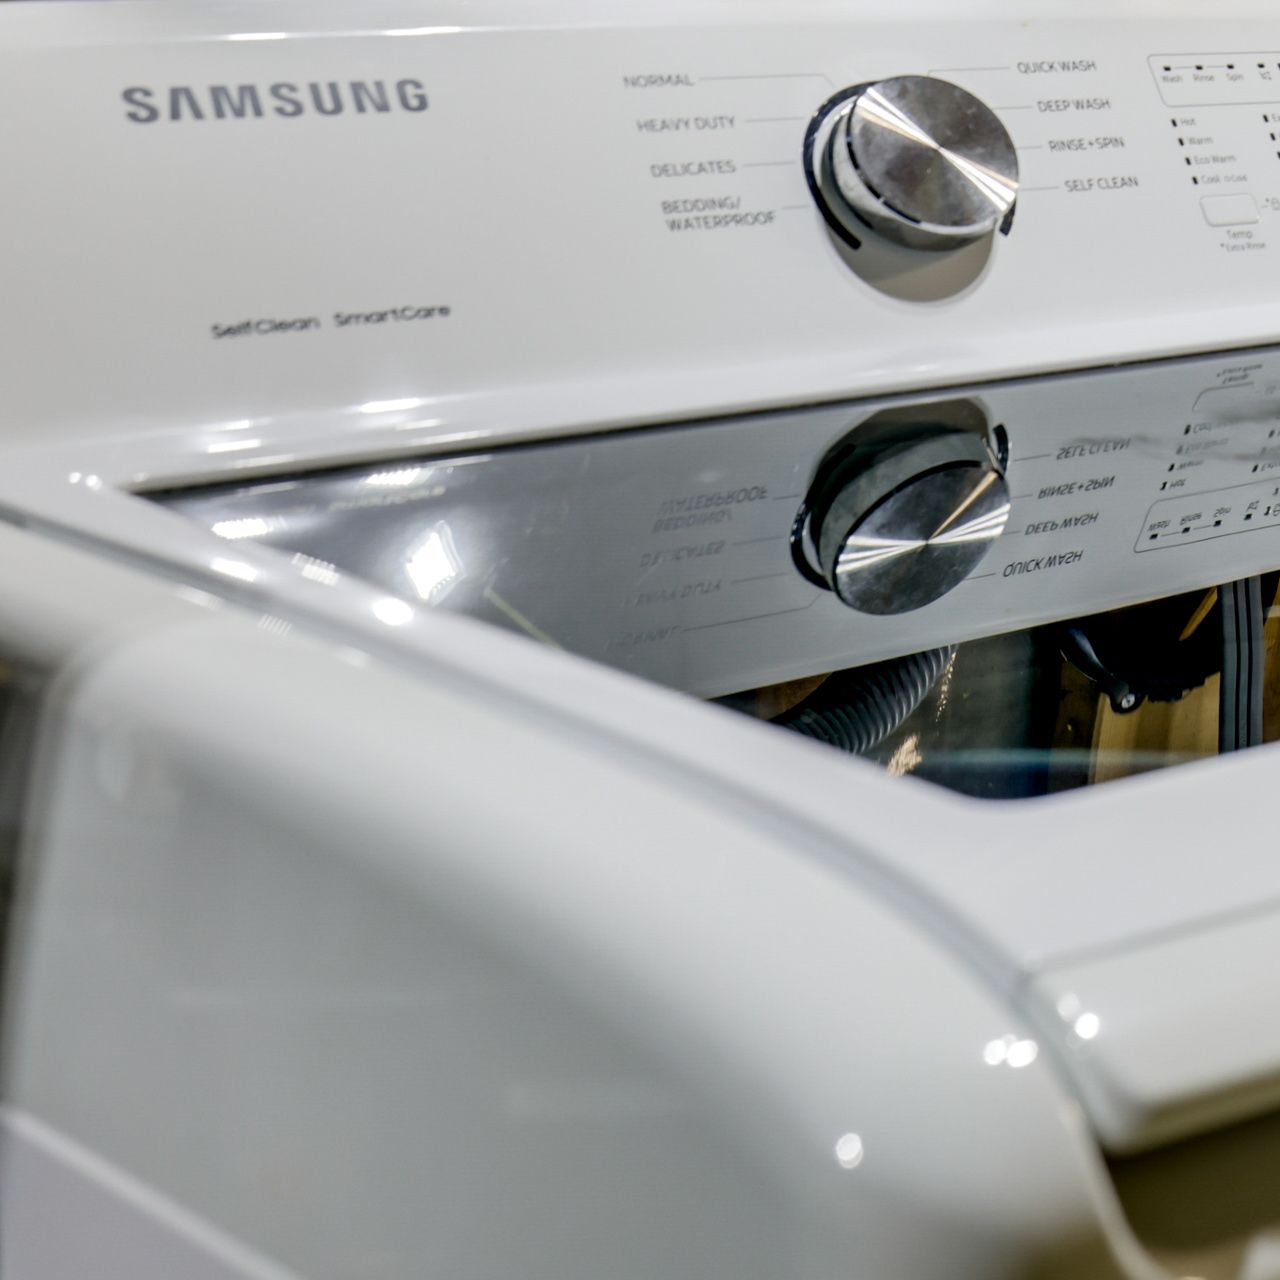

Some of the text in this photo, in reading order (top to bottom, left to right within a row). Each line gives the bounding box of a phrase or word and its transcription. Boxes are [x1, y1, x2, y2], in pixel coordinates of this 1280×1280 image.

[1016, 59, 1097, 75] QUICK WASH
[622, 73, 695, 89] NORMAL
[121, 77, 430, 125] SAMSUNG
[1036, 97, 1112, 113] DEEP WASH
[635, 115, 736, 133] HEAVY DUTY
[1048, 138, 1087, 152] RINSE
[1095, 136, 1126, 150] SPIN
[650, 159, 736, 178] DELICATES
[1063, 176, 1140, 193] SELF CLEAN
[660, 195, 742, 215] BEDDING/
[665, 210, 776, 232] WATERPROOF
